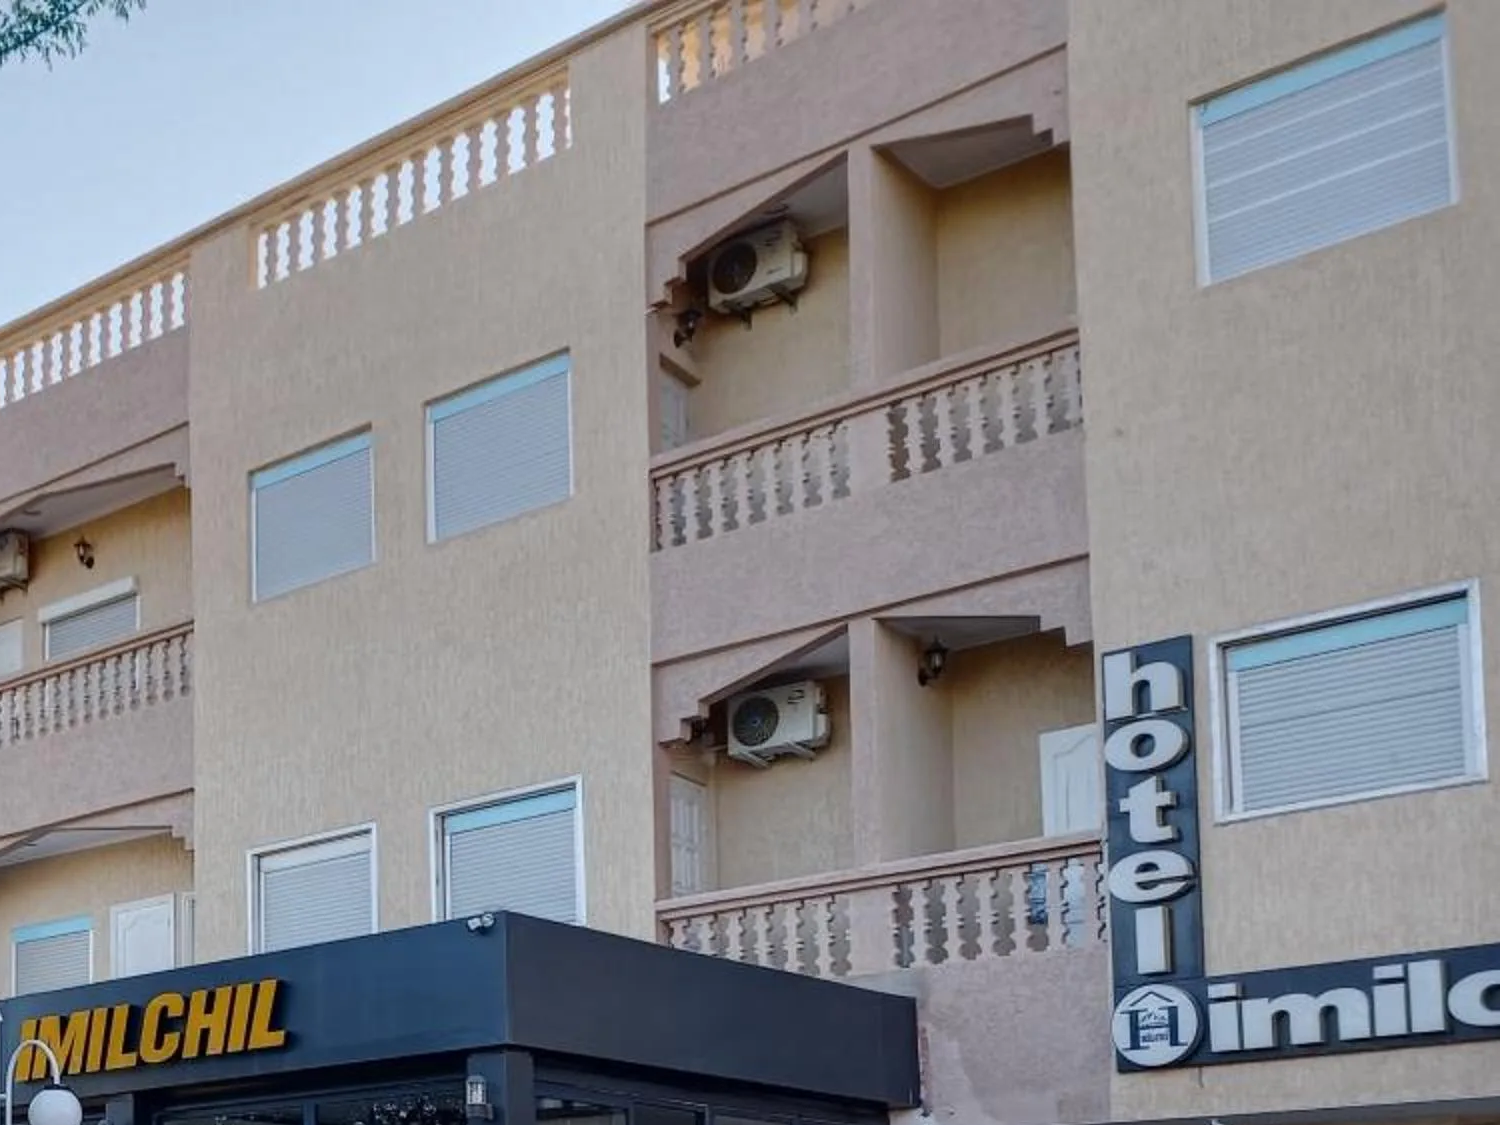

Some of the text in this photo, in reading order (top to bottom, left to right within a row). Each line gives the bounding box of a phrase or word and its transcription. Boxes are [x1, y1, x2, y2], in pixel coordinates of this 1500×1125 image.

[1103, 651, 1197, 975] hotel
[15, 978, 285, 1082] IMILCHIL
[1207, 959, 1500, 1054] imilc
